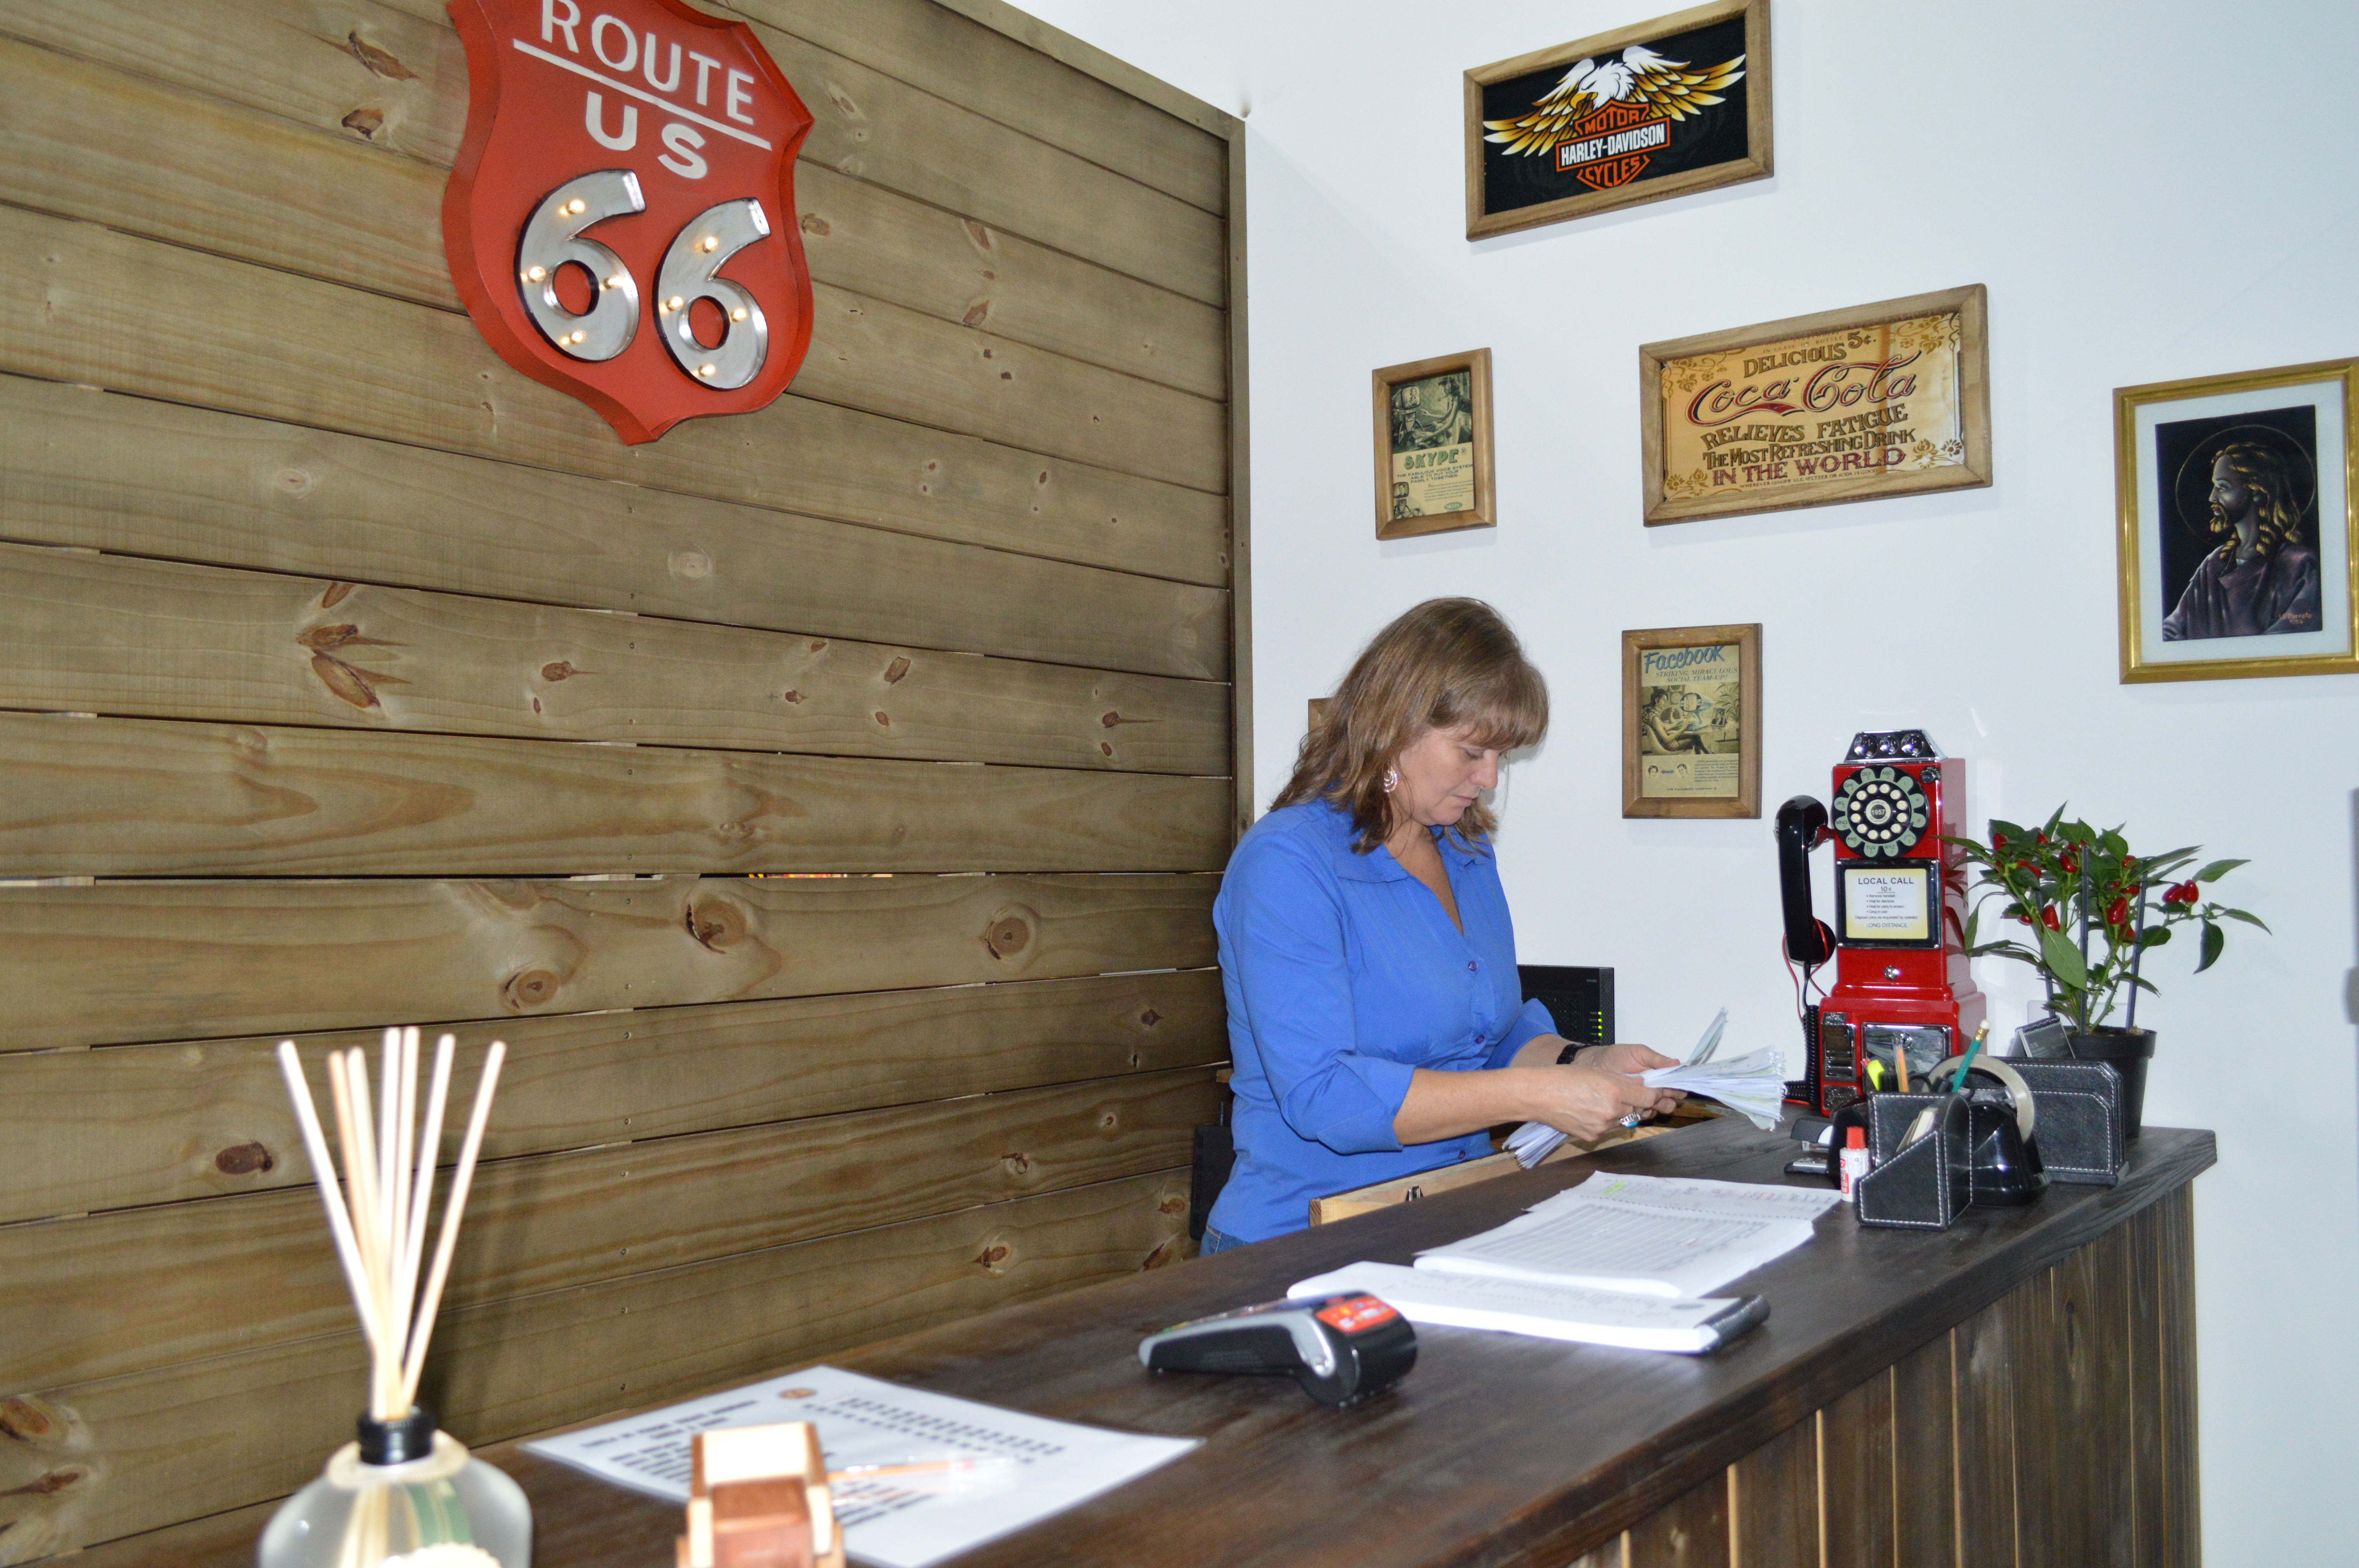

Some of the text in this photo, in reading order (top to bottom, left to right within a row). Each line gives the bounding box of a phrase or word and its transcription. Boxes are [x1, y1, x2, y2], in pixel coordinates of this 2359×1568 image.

[542, 0, 754, 125] ROUTE
[585, 91, 707, 180] US
[1585, 106, 1640, 134] MOTOR
[1561, 123, 1665, 166] HARLEY-DAVIDSON
[1585, 156, 1640, 187] CYCLES
[514, 169, 771, 390] 66
[1743, 343, 1847, 378] DELICIOUS
[1701, 403, 1908, 451] RELIEVES FATIGUE
[1404, 448, 1459, 470] SKYPE
[1712, 447, 1907, 486] IN THE WORLD
[1643, 646, 1725, 674] Facebook
[1692, 668, 1737, 676] MIRACULOUS
